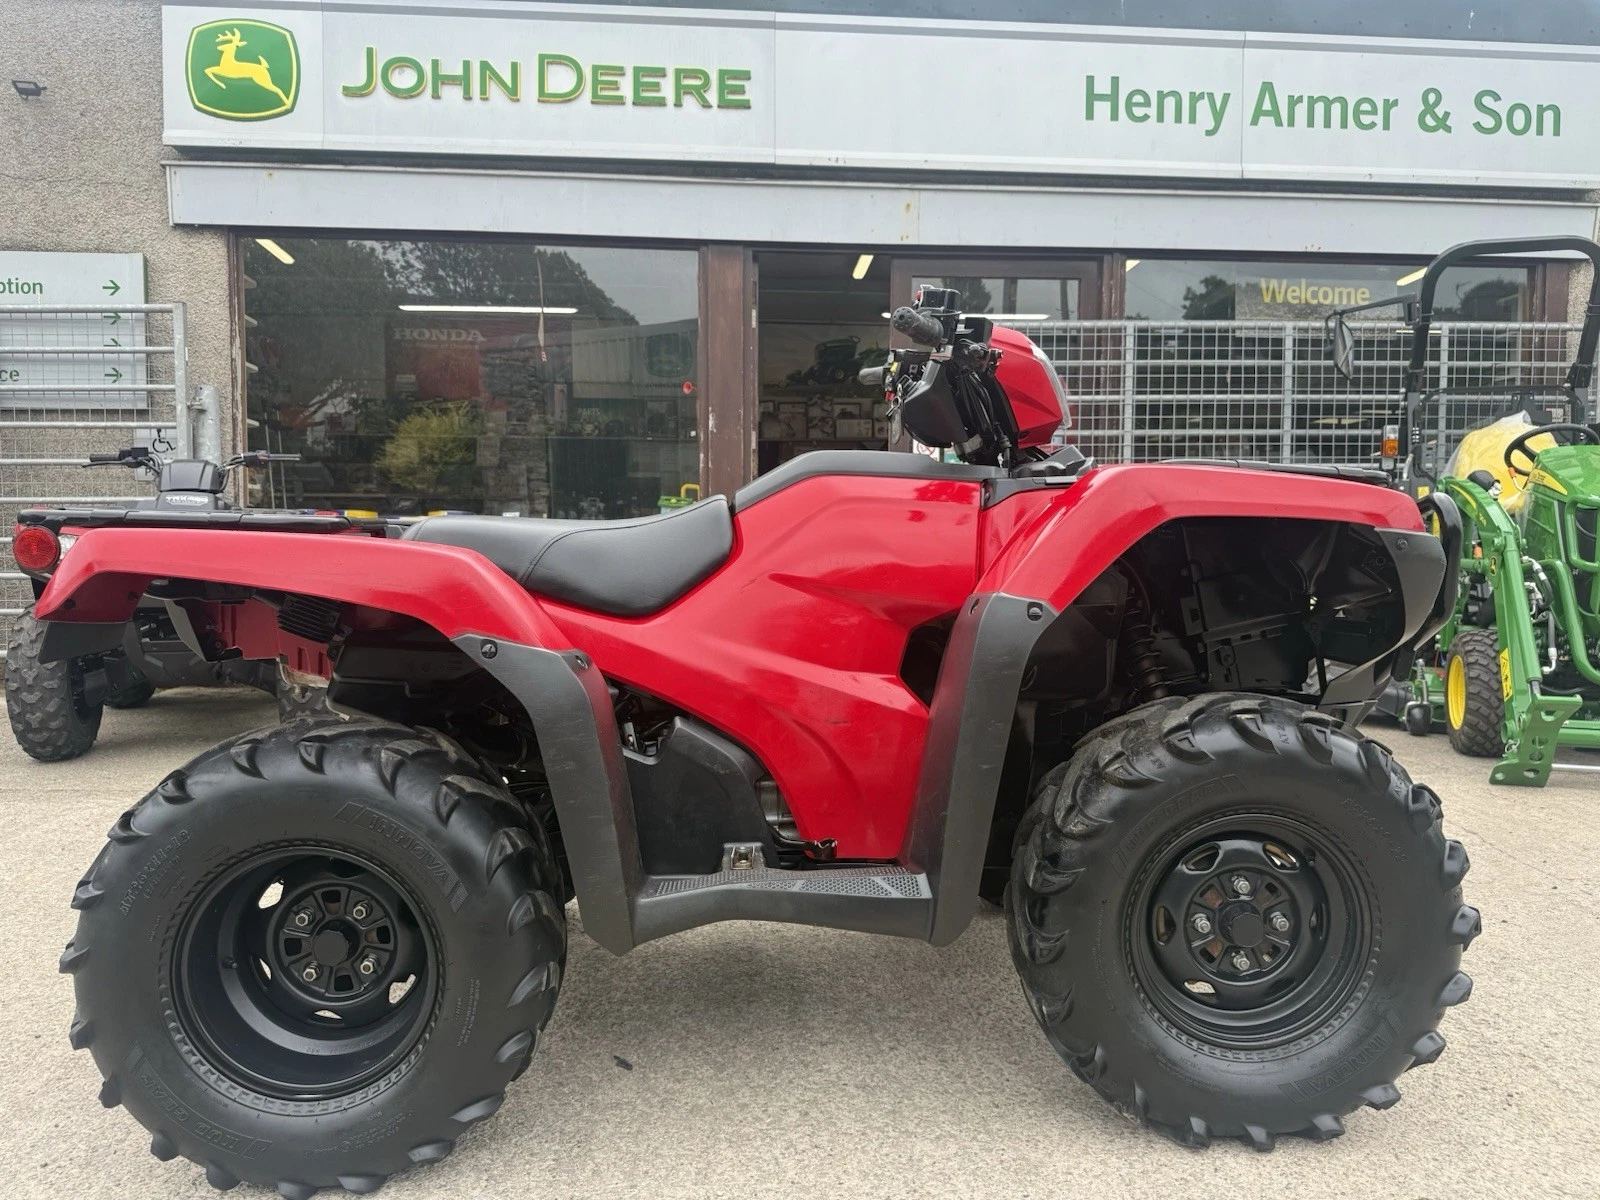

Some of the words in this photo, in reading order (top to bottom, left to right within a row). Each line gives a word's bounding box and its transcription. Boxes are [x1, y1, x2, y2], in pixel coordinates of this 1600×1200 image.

[342, 46, 520, 102] JOHN
[537, 53, 752, 109] DEERE
[1085, 75, 1231, 136] Henry
[1249, 81, 1399, 131] Armer
[1417, 87, 1452, 134] &
[1472, 89, 1562, 137] Son
[1260, 277, 1370, 305] Welcome
[393, 328, 487, 341] HONDA
[577, 407, 601, 416] PARTS
